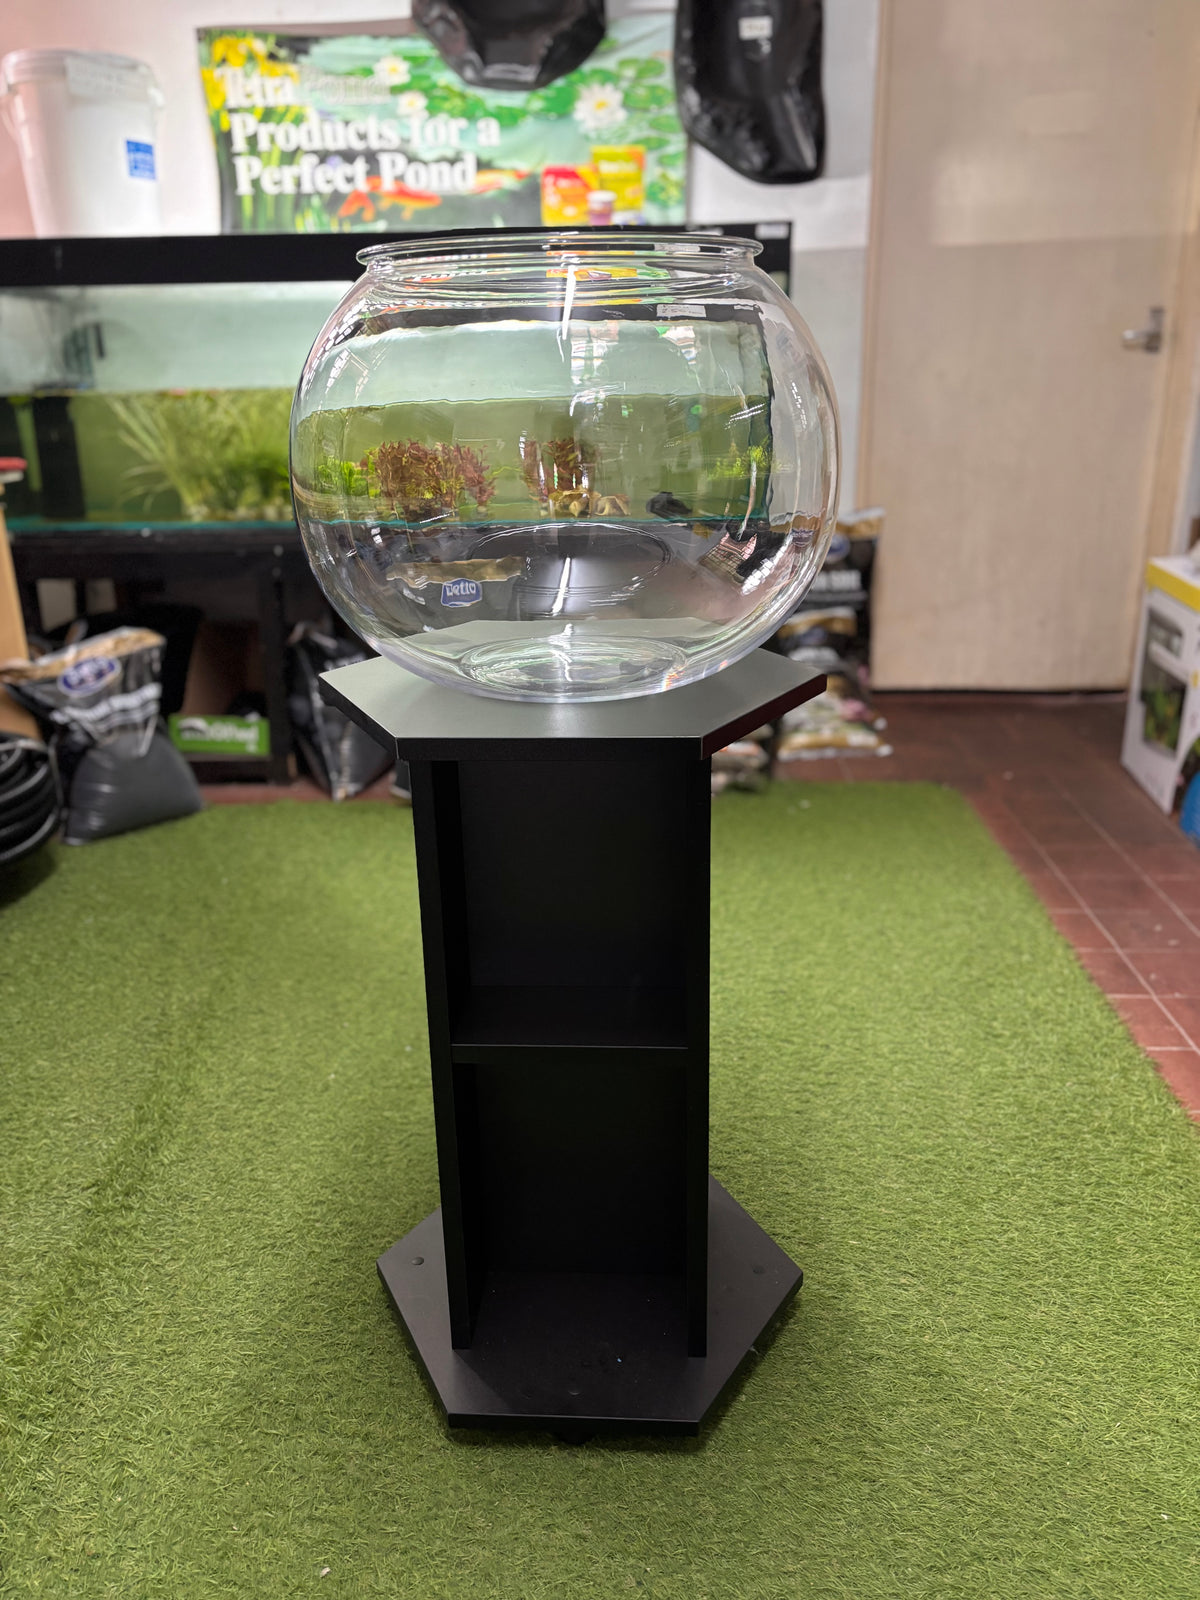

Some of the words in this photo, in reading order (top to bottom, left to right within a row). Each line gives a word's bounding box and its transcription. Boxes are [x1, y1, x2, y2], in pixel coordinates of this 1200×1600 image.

[217, 67, 295, 107] Tetra
[231, 109, 400, 152] Products
[409, 113, 468, 149] for
[477, 116, 500, 147] a
[235, 153, 369, 195] Perfect
[377, 151, 479, 195] Pond
